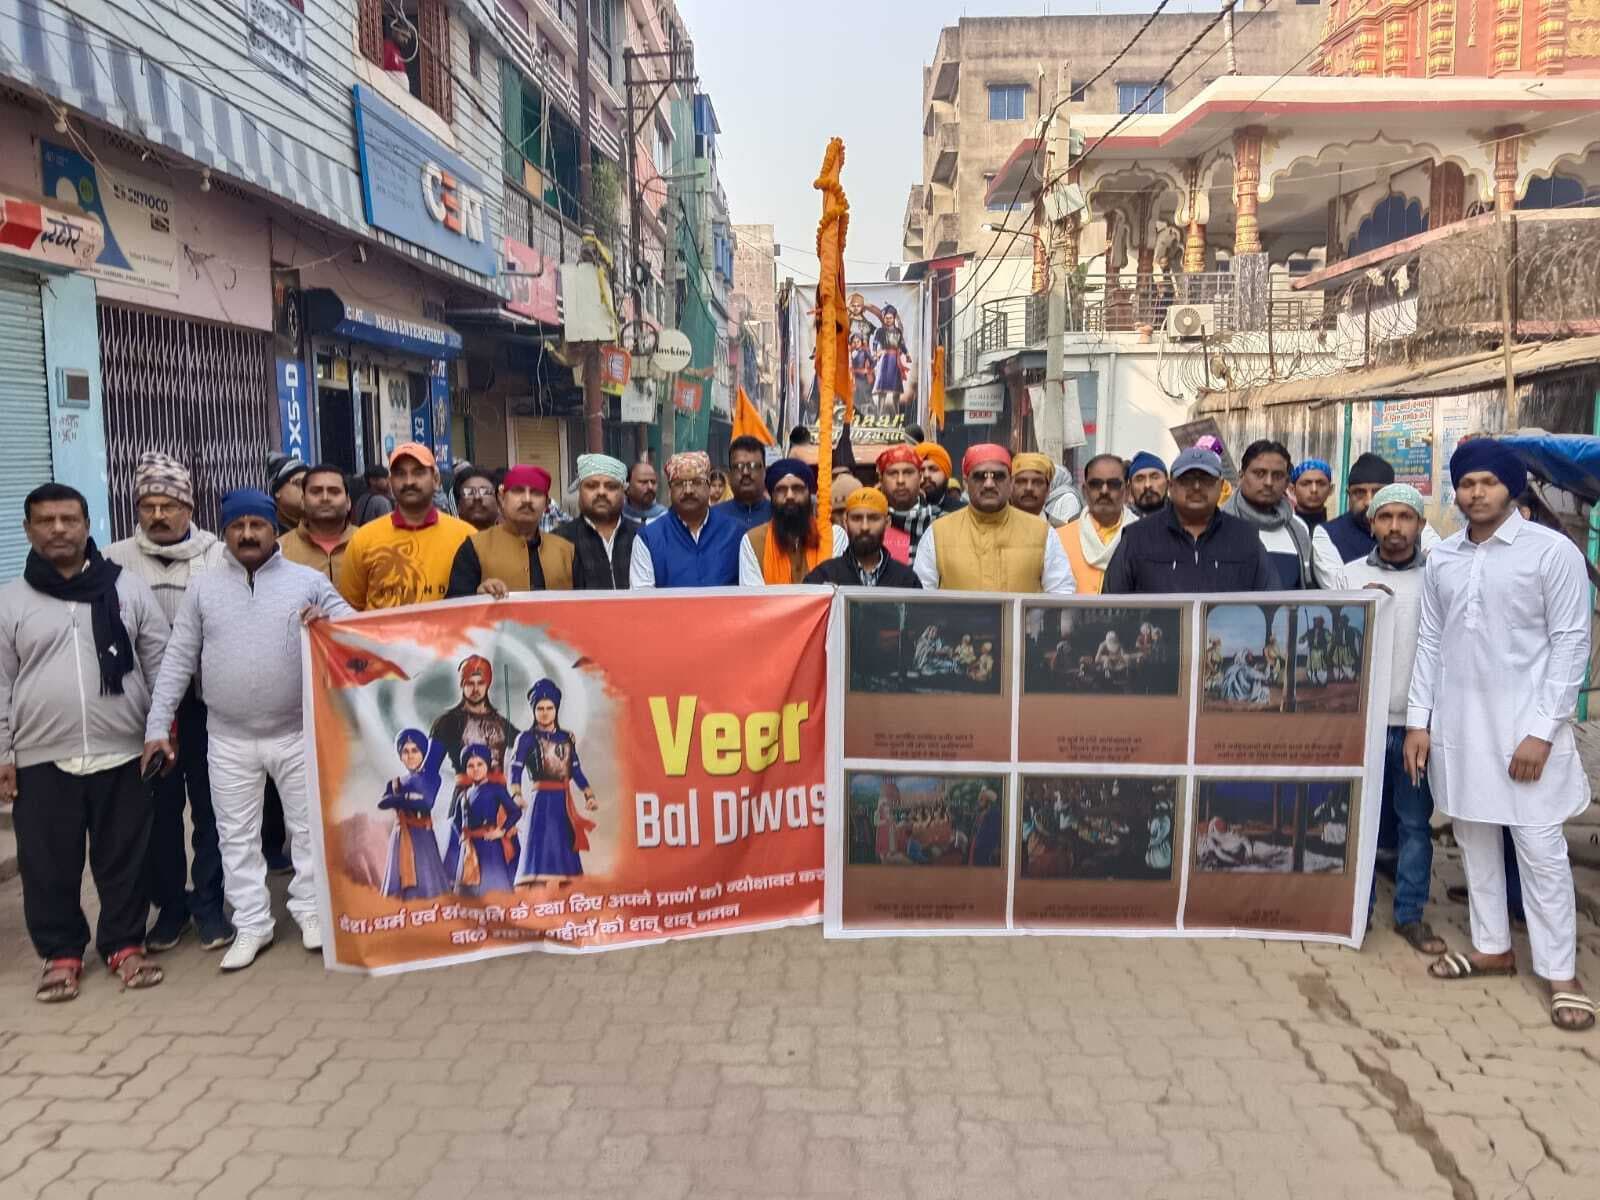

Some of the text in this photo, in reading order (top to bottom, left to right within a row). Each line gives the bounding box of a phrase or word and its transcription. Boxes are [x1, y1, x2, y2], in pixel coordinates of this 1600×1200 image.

[399, 319, 446, 345] ENTERPRISES
[654, 344, 691, 357] awkins
[648, 696, 809, 777] Veer
[635, 783, 826, 848] Bal Diwas
[411, 903, 439, 926] एवं
[510, 901, 528, 920] के
[534, 899, 565, 917] रक्षा
[569, 893, 603, 914] लिए
[608, 889, 651, 908] अपने
[656, 885, 697, 906] प्राणों
[699, 884, 722, 901] को
[600, 917, 623, 934] को
[697, 903, 741, 922] नमन
